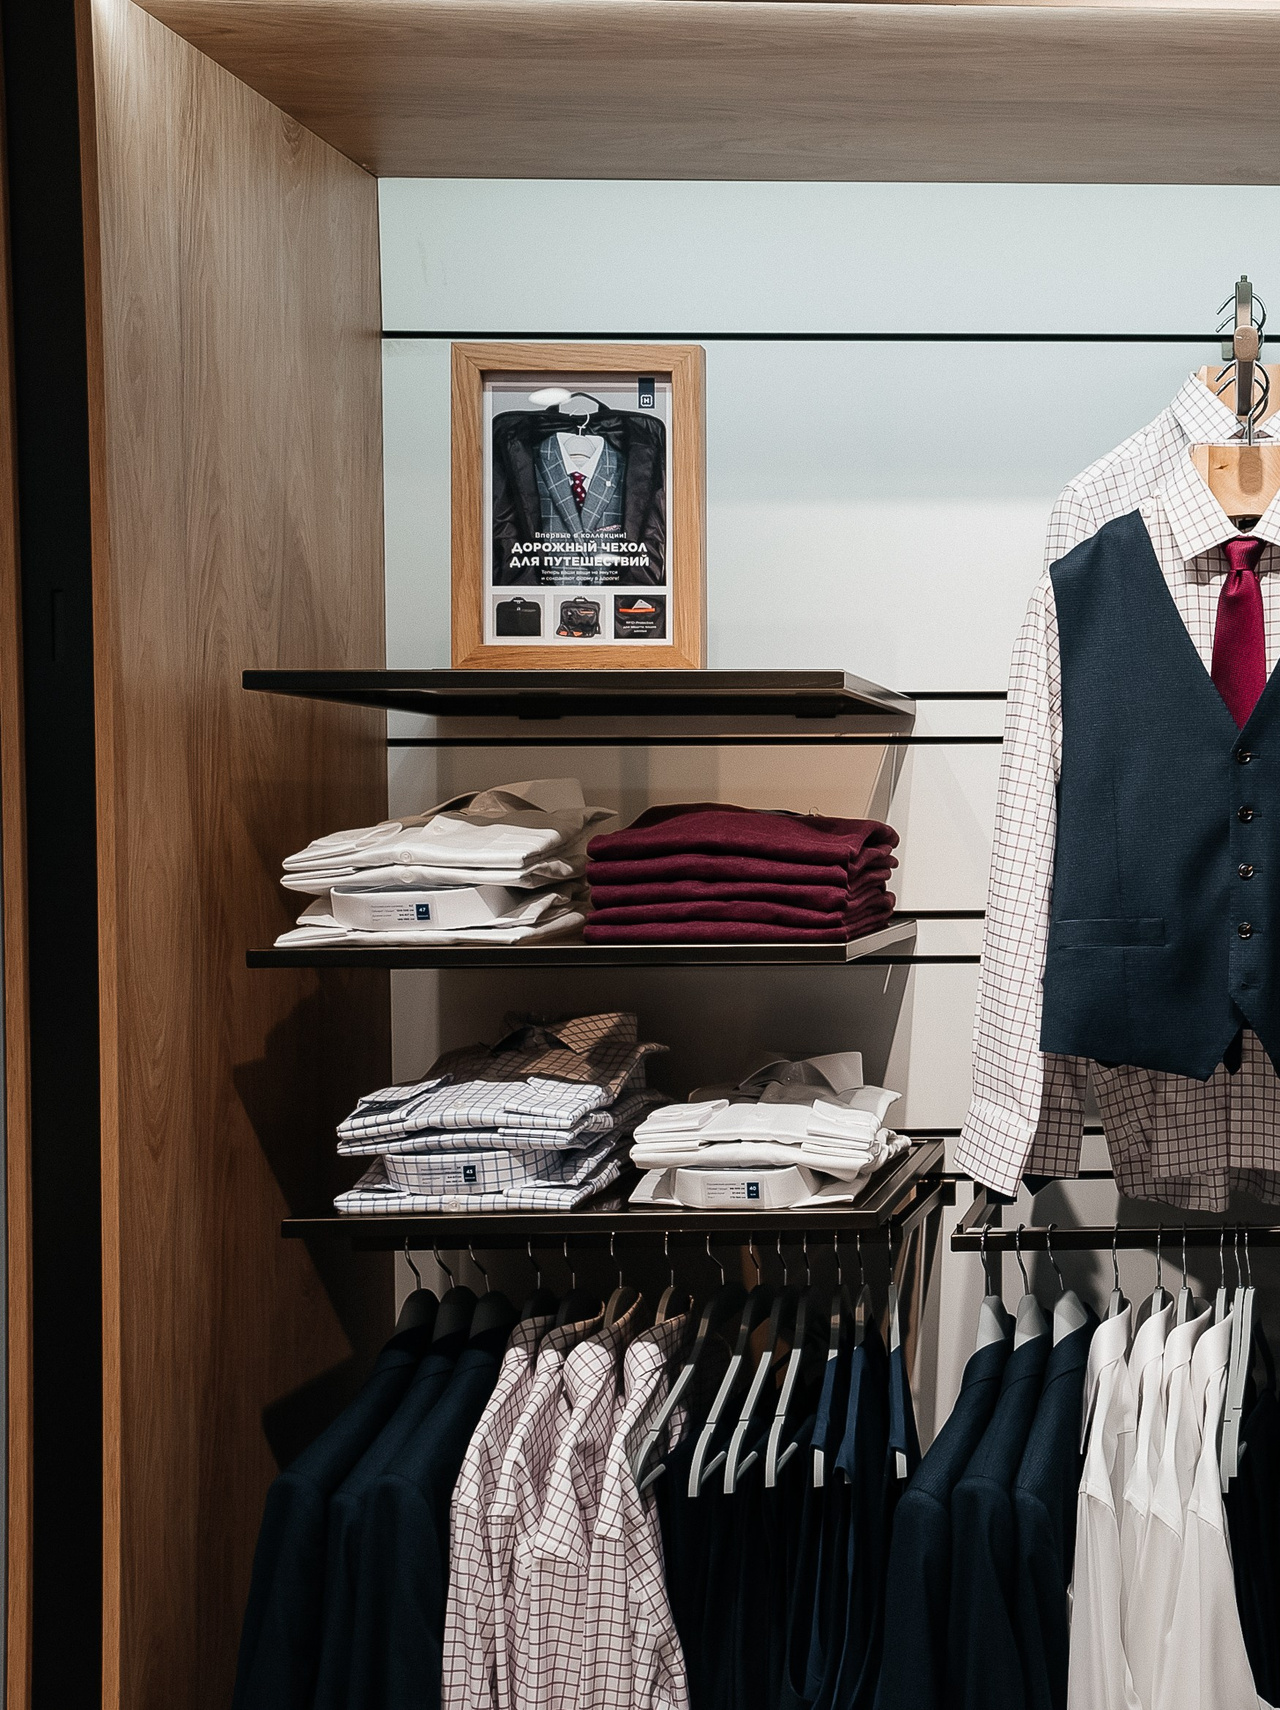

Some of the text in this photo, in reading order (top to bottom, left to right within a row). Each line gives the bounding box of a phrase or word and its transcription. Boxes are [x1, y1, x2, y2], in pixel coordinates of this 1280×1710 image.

[535, 532, 571, 540] Впервые
[581, 532, 627, 540] коллекции!
[511, 540, 648, 554] ДОРОЖНЫЙ ЧЕХОЛ
[509, 554, 650, 568] ДЛЯ ПУТЕШЕСТВИЙ
